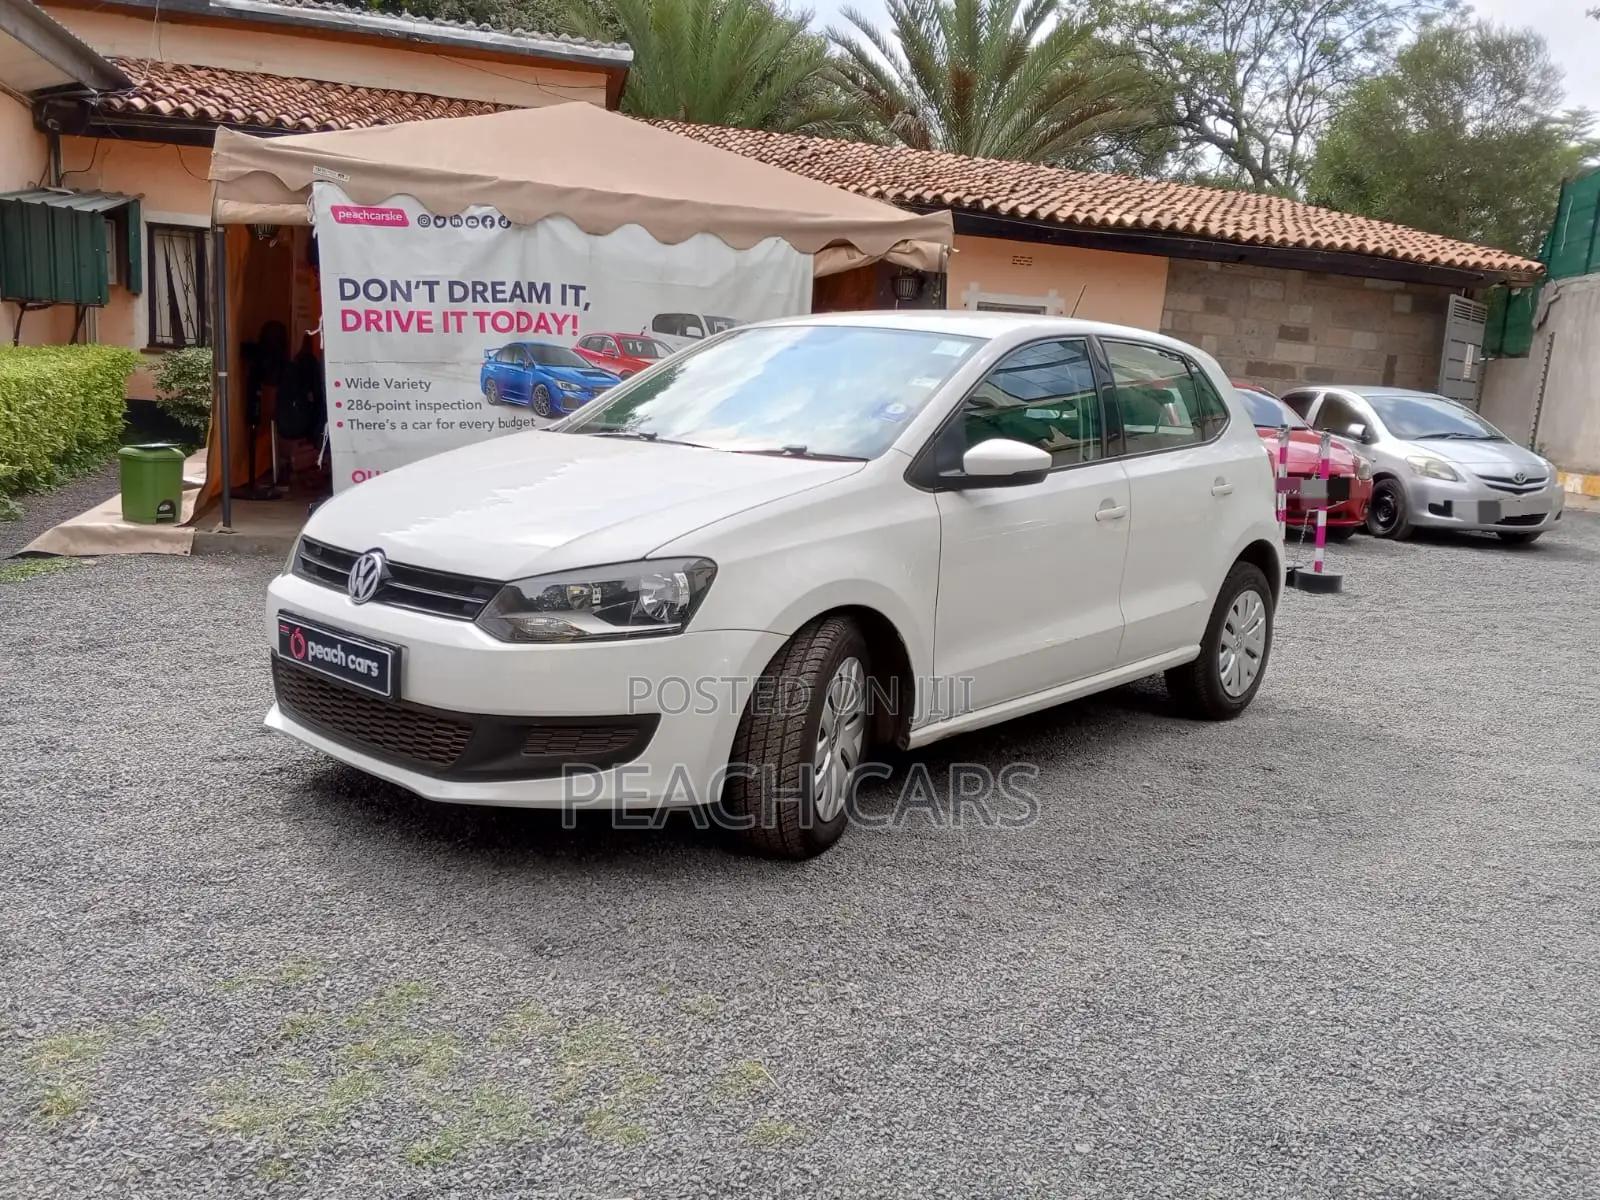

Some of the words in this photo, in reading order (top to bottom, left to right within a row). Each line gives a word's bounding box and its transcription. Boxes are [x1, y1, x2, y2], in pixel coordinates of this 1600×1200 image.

[338, 208, 403, 223] peachcarske
[338, 278, 440, 303] DON'T
[448, 280, 550, 304] DREAM
[560, 283, 591, 311] IT,
[340, 309, 433, 333] DRIVE
[442, 310, 468, 333] IT
[473, 311, 579, 336] TODAY!
[344, 377, 380, 390] Wide
[384, 378, 432, 393] Variety
[346, 399, 412, 414] 286-point
[415, 399, 483, 413] inspection
[347, 418, 397, 431] There's
[400, 421, 408, 431] a
[411, 421, 433, 431] car
[435, 417, 456, 431] for
[458, 420, 495, 433] every
[499, 416, 536, 432] budget
[308, 641, 345, 666] peach
[348, 654, 378, 677] cars
